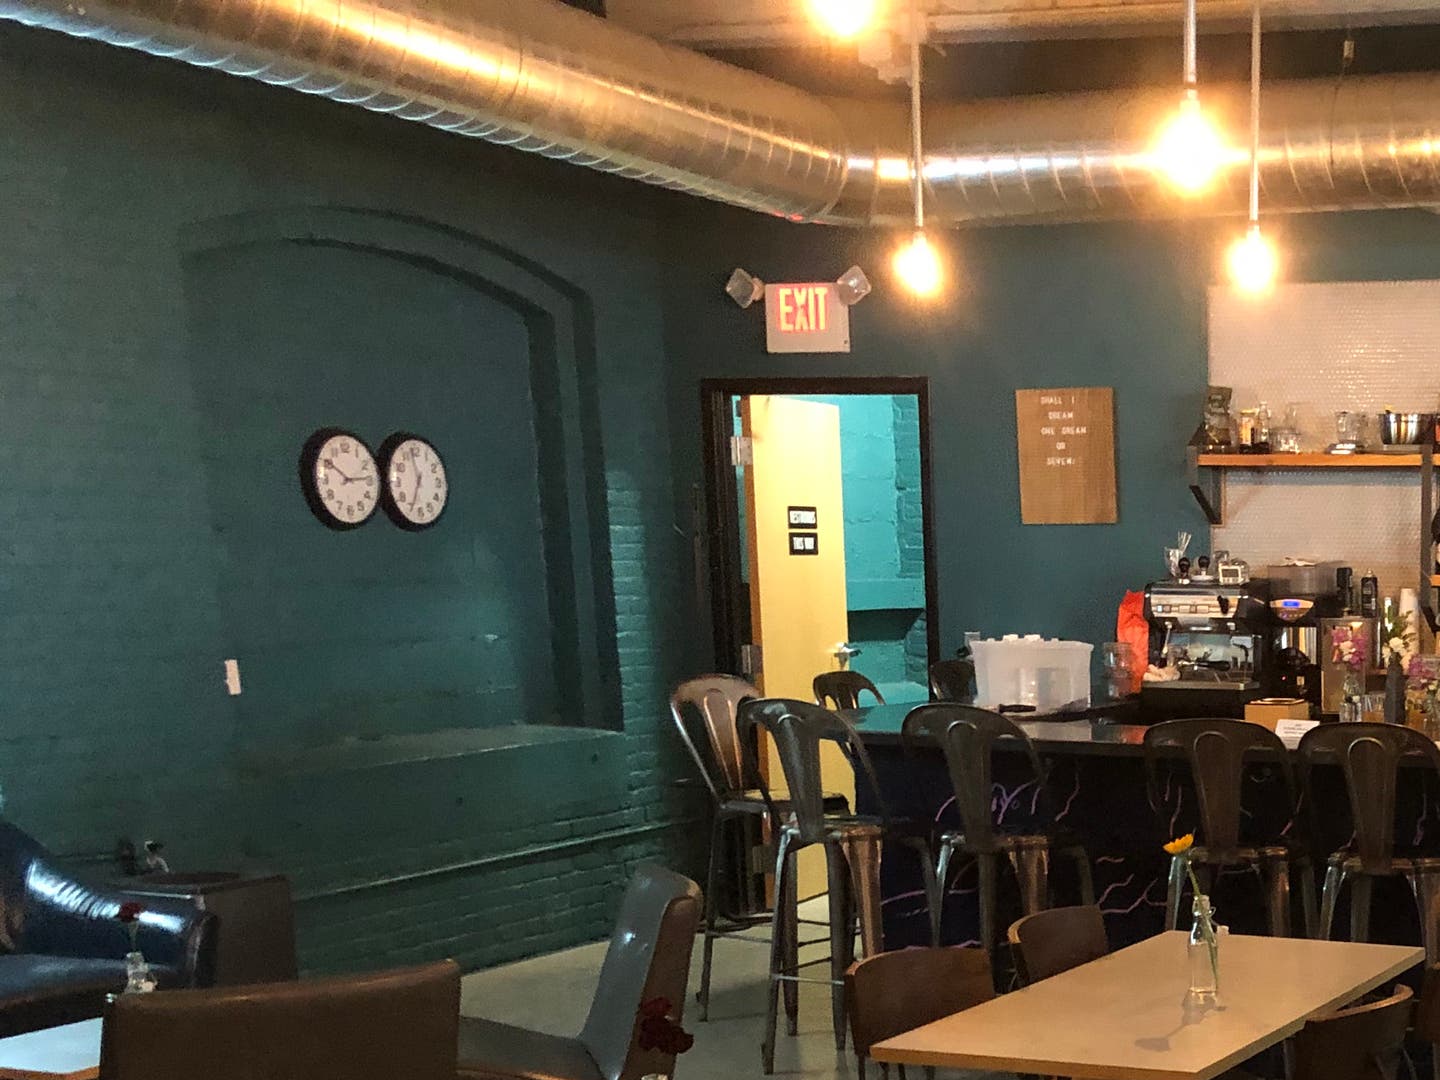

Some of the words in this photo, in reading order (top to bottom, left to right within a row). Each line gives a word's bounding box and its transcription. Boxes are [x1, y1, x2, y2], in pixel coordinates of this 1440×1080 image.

[779, 287, 828, 331] EXIT
[340, 442, 350, 454] 12
[1055, 442, 1066, 450] OR
[396, 462, 406, 473] 10
[431, 463, 438, 474] 2
[327, 488, 334, 501] 8
[399, 491, 406, 503] 8
[336, 500, 343, 511] 7
[347, 504, 354, 517] 6
[357, 500, 365, 512] 5
[427, 502, 434, 513] 5
[417, 506, 424, 518] 6
